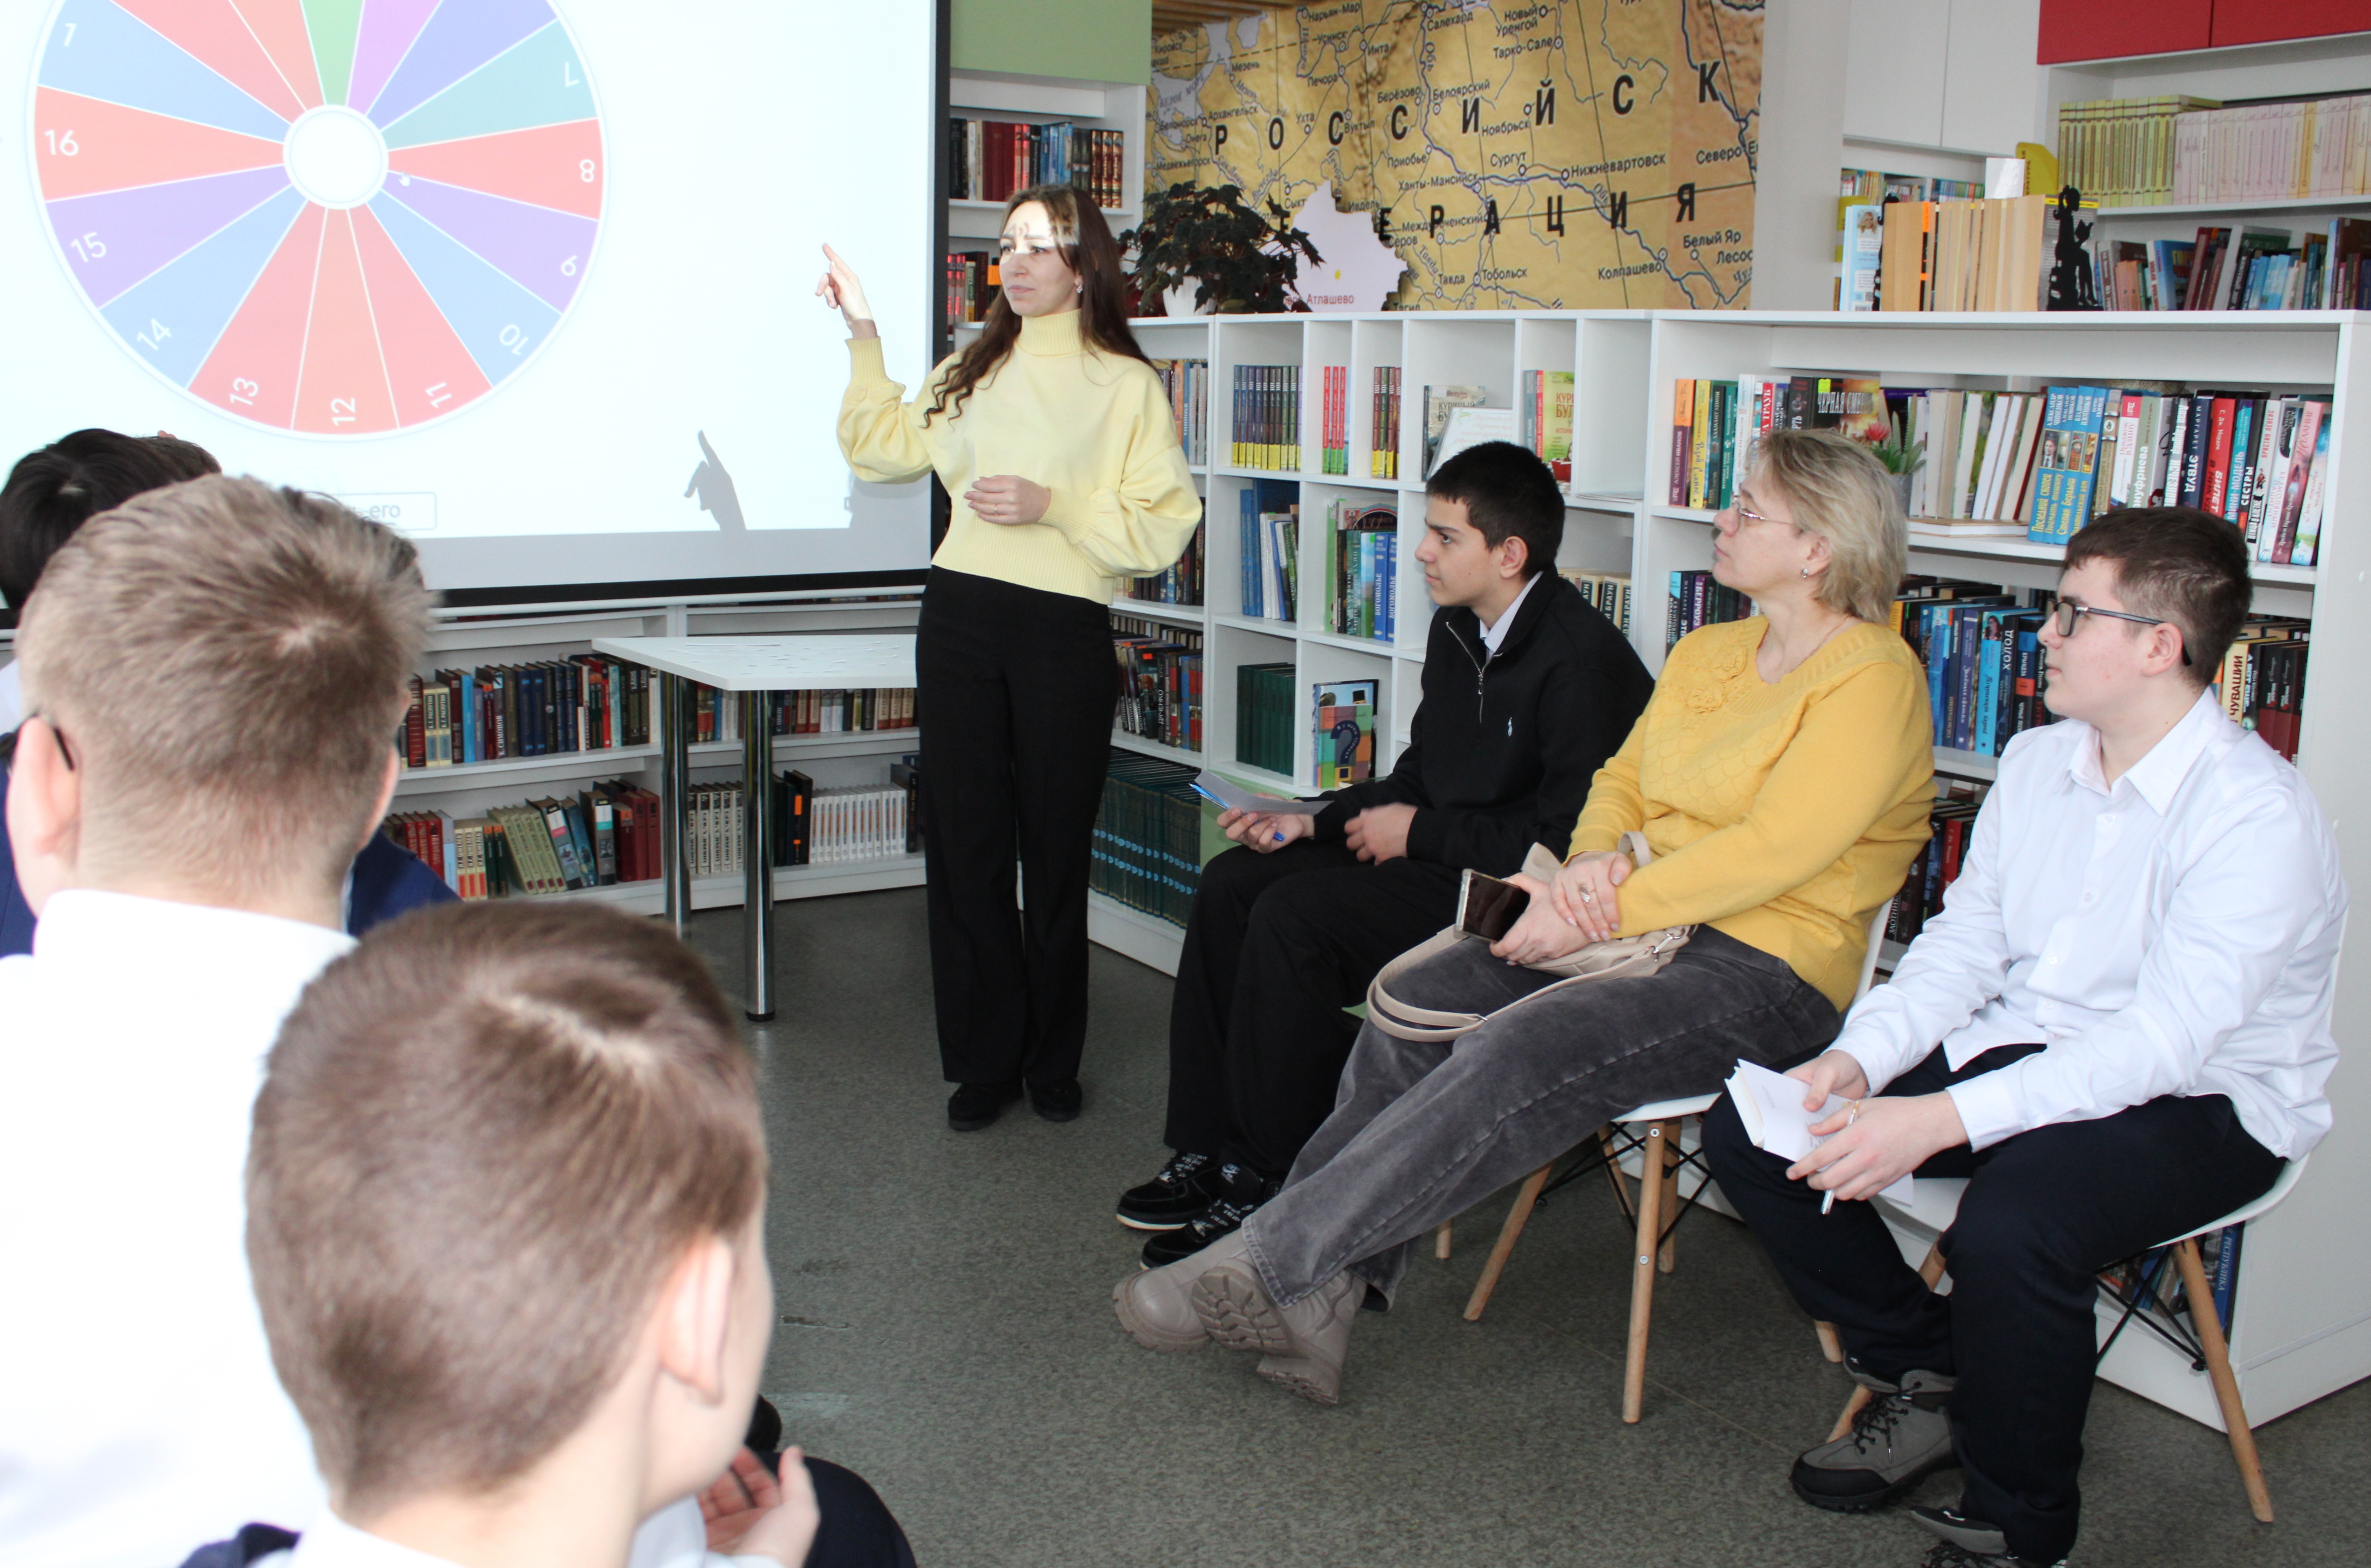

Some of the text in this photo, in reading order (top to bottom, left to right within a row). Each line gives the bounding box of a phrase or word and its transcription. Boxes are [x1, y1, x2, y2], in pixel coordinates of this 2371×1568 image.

[1309, 3, 1360, 22] Нарьян-Мар
[1427, 11, 1473, 31] Салехард
[1505, 4, 1538, 22] Новый
[1496, 17, 1538, 37] Уренгой
[1368, 43, 1389, 55] Инта
[1493, 37, 1553, 58] Тарко-Сале
[564, 62, 580, 88] 7
[1232, 61, 1260, 72] Мезень
[1308, 74, 1338, 87] Печора
[1433, 79, 1490, 100] Белоярский
[1209, 107, 1258, 122] Архангельск
[1296, 113, 1316, 123] Ухта
[1345, 120, 1375, 134] Вуктыл
[1481, 121, 1530, 137] Ноябрьск
[44, 129, 79, 157] 16
[1387, 153, 1426, 168] Приобье
[1490, 152, 1527, 167] Сургут
[1571, 154, 1666, 179] Нижневартовск
[580, 159, 595, 183] 8
[1398, 172, 1478, 192] Ханты-Мансийск
[70, 232, 108, 263] 15
[1684, 229, 1741, 248] Белый Яр
[560, 255, 578, 277] 9
[1482, 267, 1528, 281] Тобольск
[1598, 261, 1661, 281] Колпашево
[1438, 274, 1465, 285] Тавда
[1307, 293, 1354, 305] Атлашево
[136, 317, 173, 351] 14
[498, 323, 530, 355] 10
[229, 377, 259, 407] 13
[425, 381, 452, 408] 11
[332, 397, 356, 426] 12
[2177, 405, 2189, 423] Лиза
[2184, 406, 2202, 492] МАРГАРЕТ ЭТВУД
[2211, 470, 2223, 513] БИЛЕТ
[2226, 452, 2245, 520] МИНИ-МОДЕЛЬ
[2241, 467, 2254, 506] СЕСТРЫ
[2032, 473, 2052, 532] Последний скопец
[2045, 474, 2064, 533] Поймать тишину
[2057, 478, 2076, 535] Степан Бердыш
[2271, 471, 2286, 528] БЕЗМОЛВНЫЙ
[1605, 584, 1614, 611] БРАУН
[2230, 655, 2243, 715] ЧУВАШИИ
[1888, 895, 1899, 935] ЗЛОТНИК
[2218, 1236, 2232, 1290] РЕСПУБЛИКА
